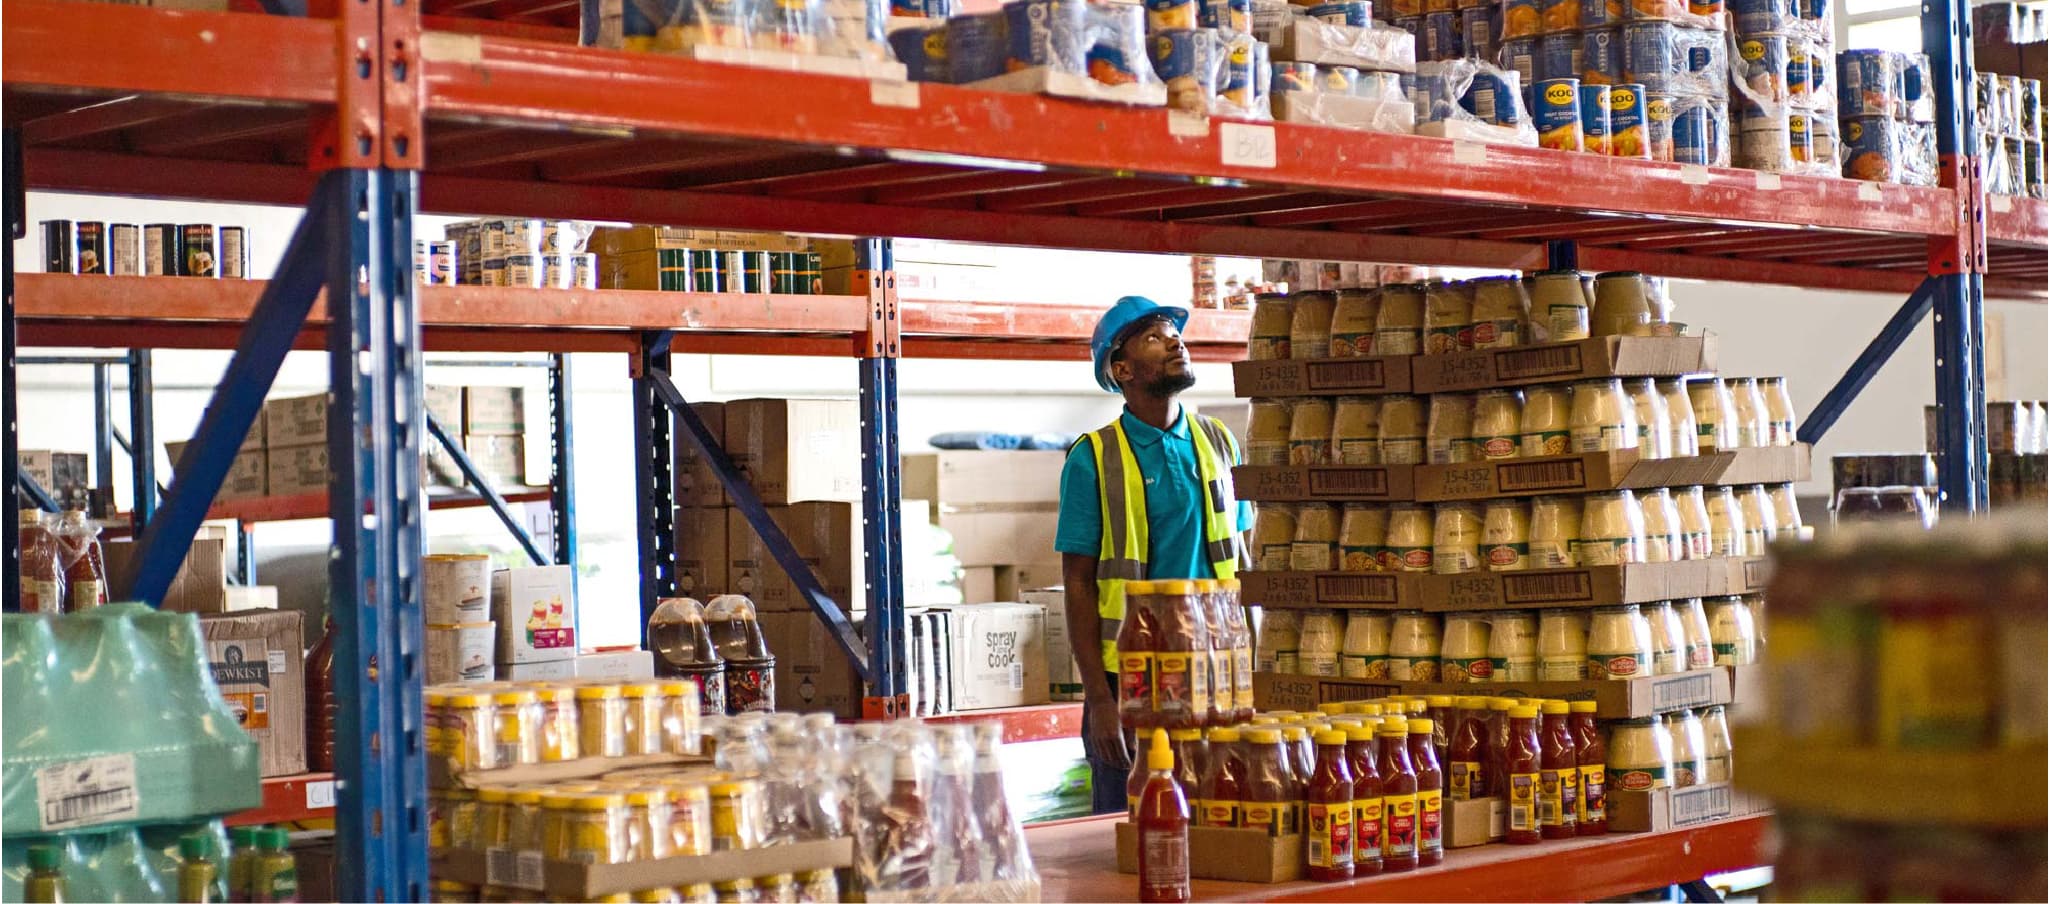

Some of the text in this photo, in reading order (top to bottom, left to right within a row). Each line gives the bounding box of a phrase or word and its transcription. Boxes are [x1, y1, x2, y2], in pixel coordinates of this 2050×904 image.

[1444, 468, 1490, 483] 15-4352
[1267, 577, 1309, 591] 15-4352
[986, 631, 1016, 652] spray
[988, 647, 1016, 668] cook
